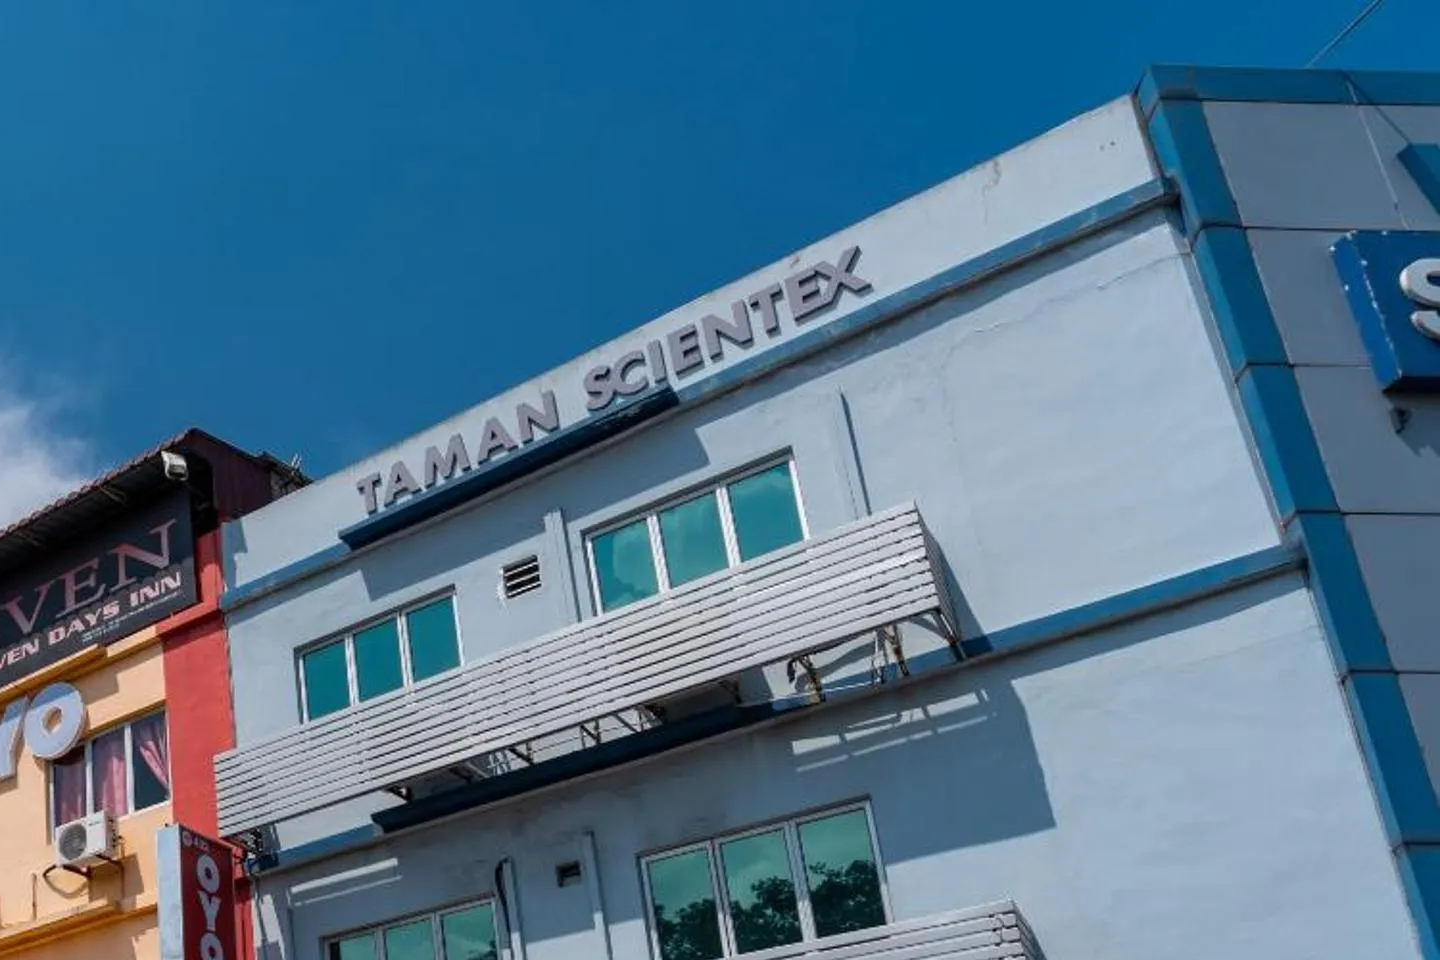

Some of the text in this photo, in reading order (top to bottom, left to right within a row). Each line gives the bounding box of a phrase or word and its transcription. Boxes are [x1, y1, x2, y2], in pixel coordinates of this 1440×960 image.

[357, 245, 873, 516] TAMAN SCIENTEX
[47, 600, 120, 646] DAYS
[129, 571, 181, 607] INN
